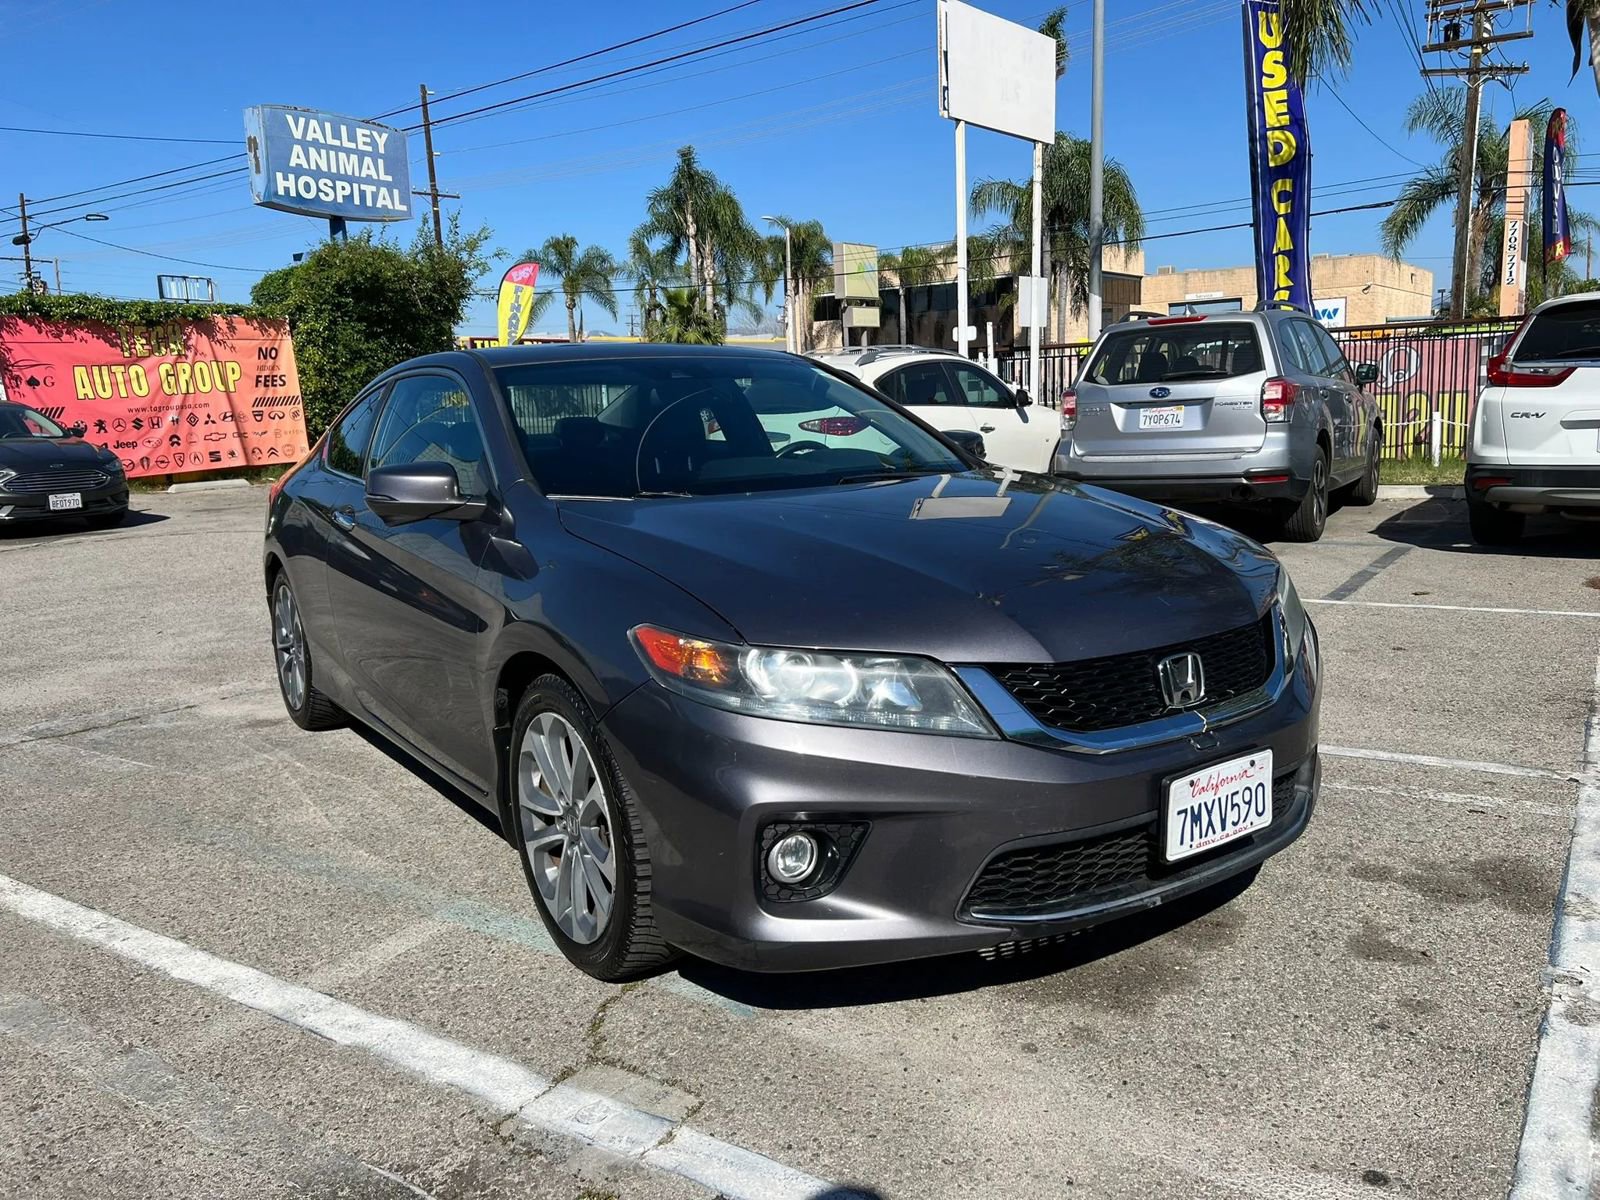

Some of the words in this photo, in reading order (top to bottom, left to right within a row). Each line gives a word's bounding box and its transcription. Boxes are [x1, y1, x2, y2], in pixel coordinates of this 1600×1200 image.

[1258, 11, 1297, 167] USED
[286, 114, 389, 154] VALLEY
[289, 145, 393, 182] ANIMAL
[275, 172, 408, 211] HOSPITAL
[115, 321, 187, 358] TECH
[257, 346, 278, 361] NO
[72, 364, 150, 400] AUTO
[158, 360, 242, 397] GROUP
[255, 374, 287, 388] FEES
[1510, 411, 1547, 419] CR-V
[113, 440, 138, 450] Jeep
[1192, 768, 1255, 798] California
[1176, 782, 1266, 846] 7MXV590
[1195, 825, 1249, 849] dmv.ca.gov
